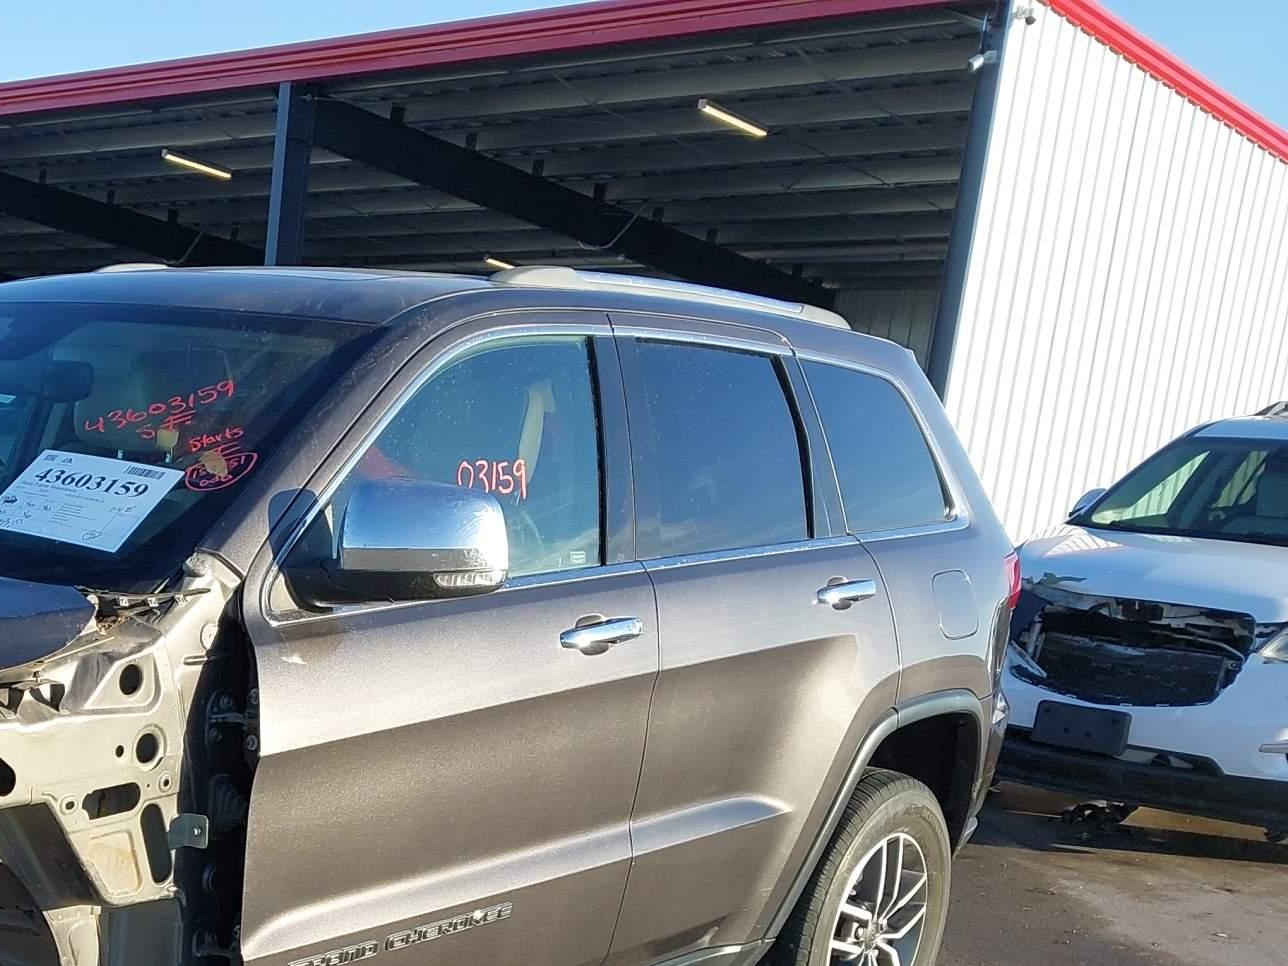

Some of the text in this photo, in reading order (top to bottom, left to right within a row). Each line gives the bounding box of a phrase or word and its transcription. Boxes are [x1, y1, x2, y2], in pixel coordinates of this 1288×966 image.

[84, 380, 235, 432] 43603159
[34, 467, 150, 498] 43603159
[457, 458, 528, 500] 03159
[384, 901, 513, 951] CHEROKEE
